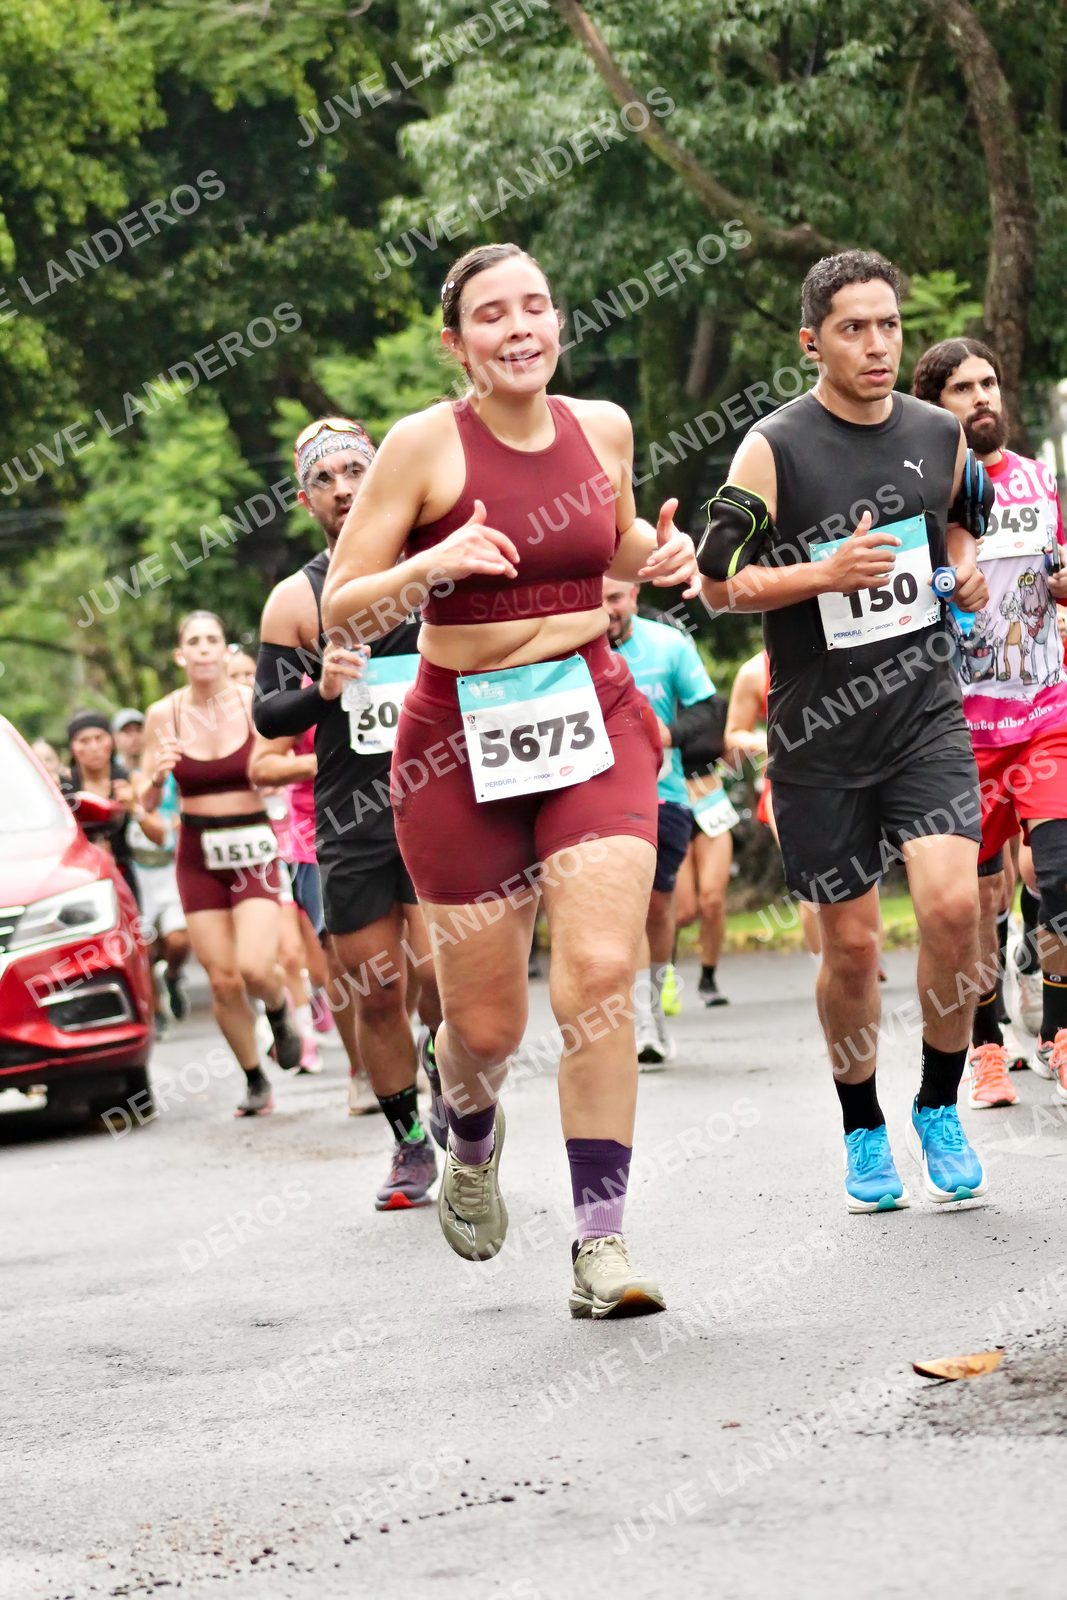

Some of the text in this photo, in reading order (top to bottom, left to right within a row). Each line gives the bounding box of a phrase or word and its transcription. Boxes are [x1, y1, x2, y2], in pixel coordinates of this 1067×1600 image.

[843, 572, 918, 618] 150
[357, 701, 400, 731] 30
[479, 711, 595, 768] 5673
[484, 778, 517, 789] PERDURA
